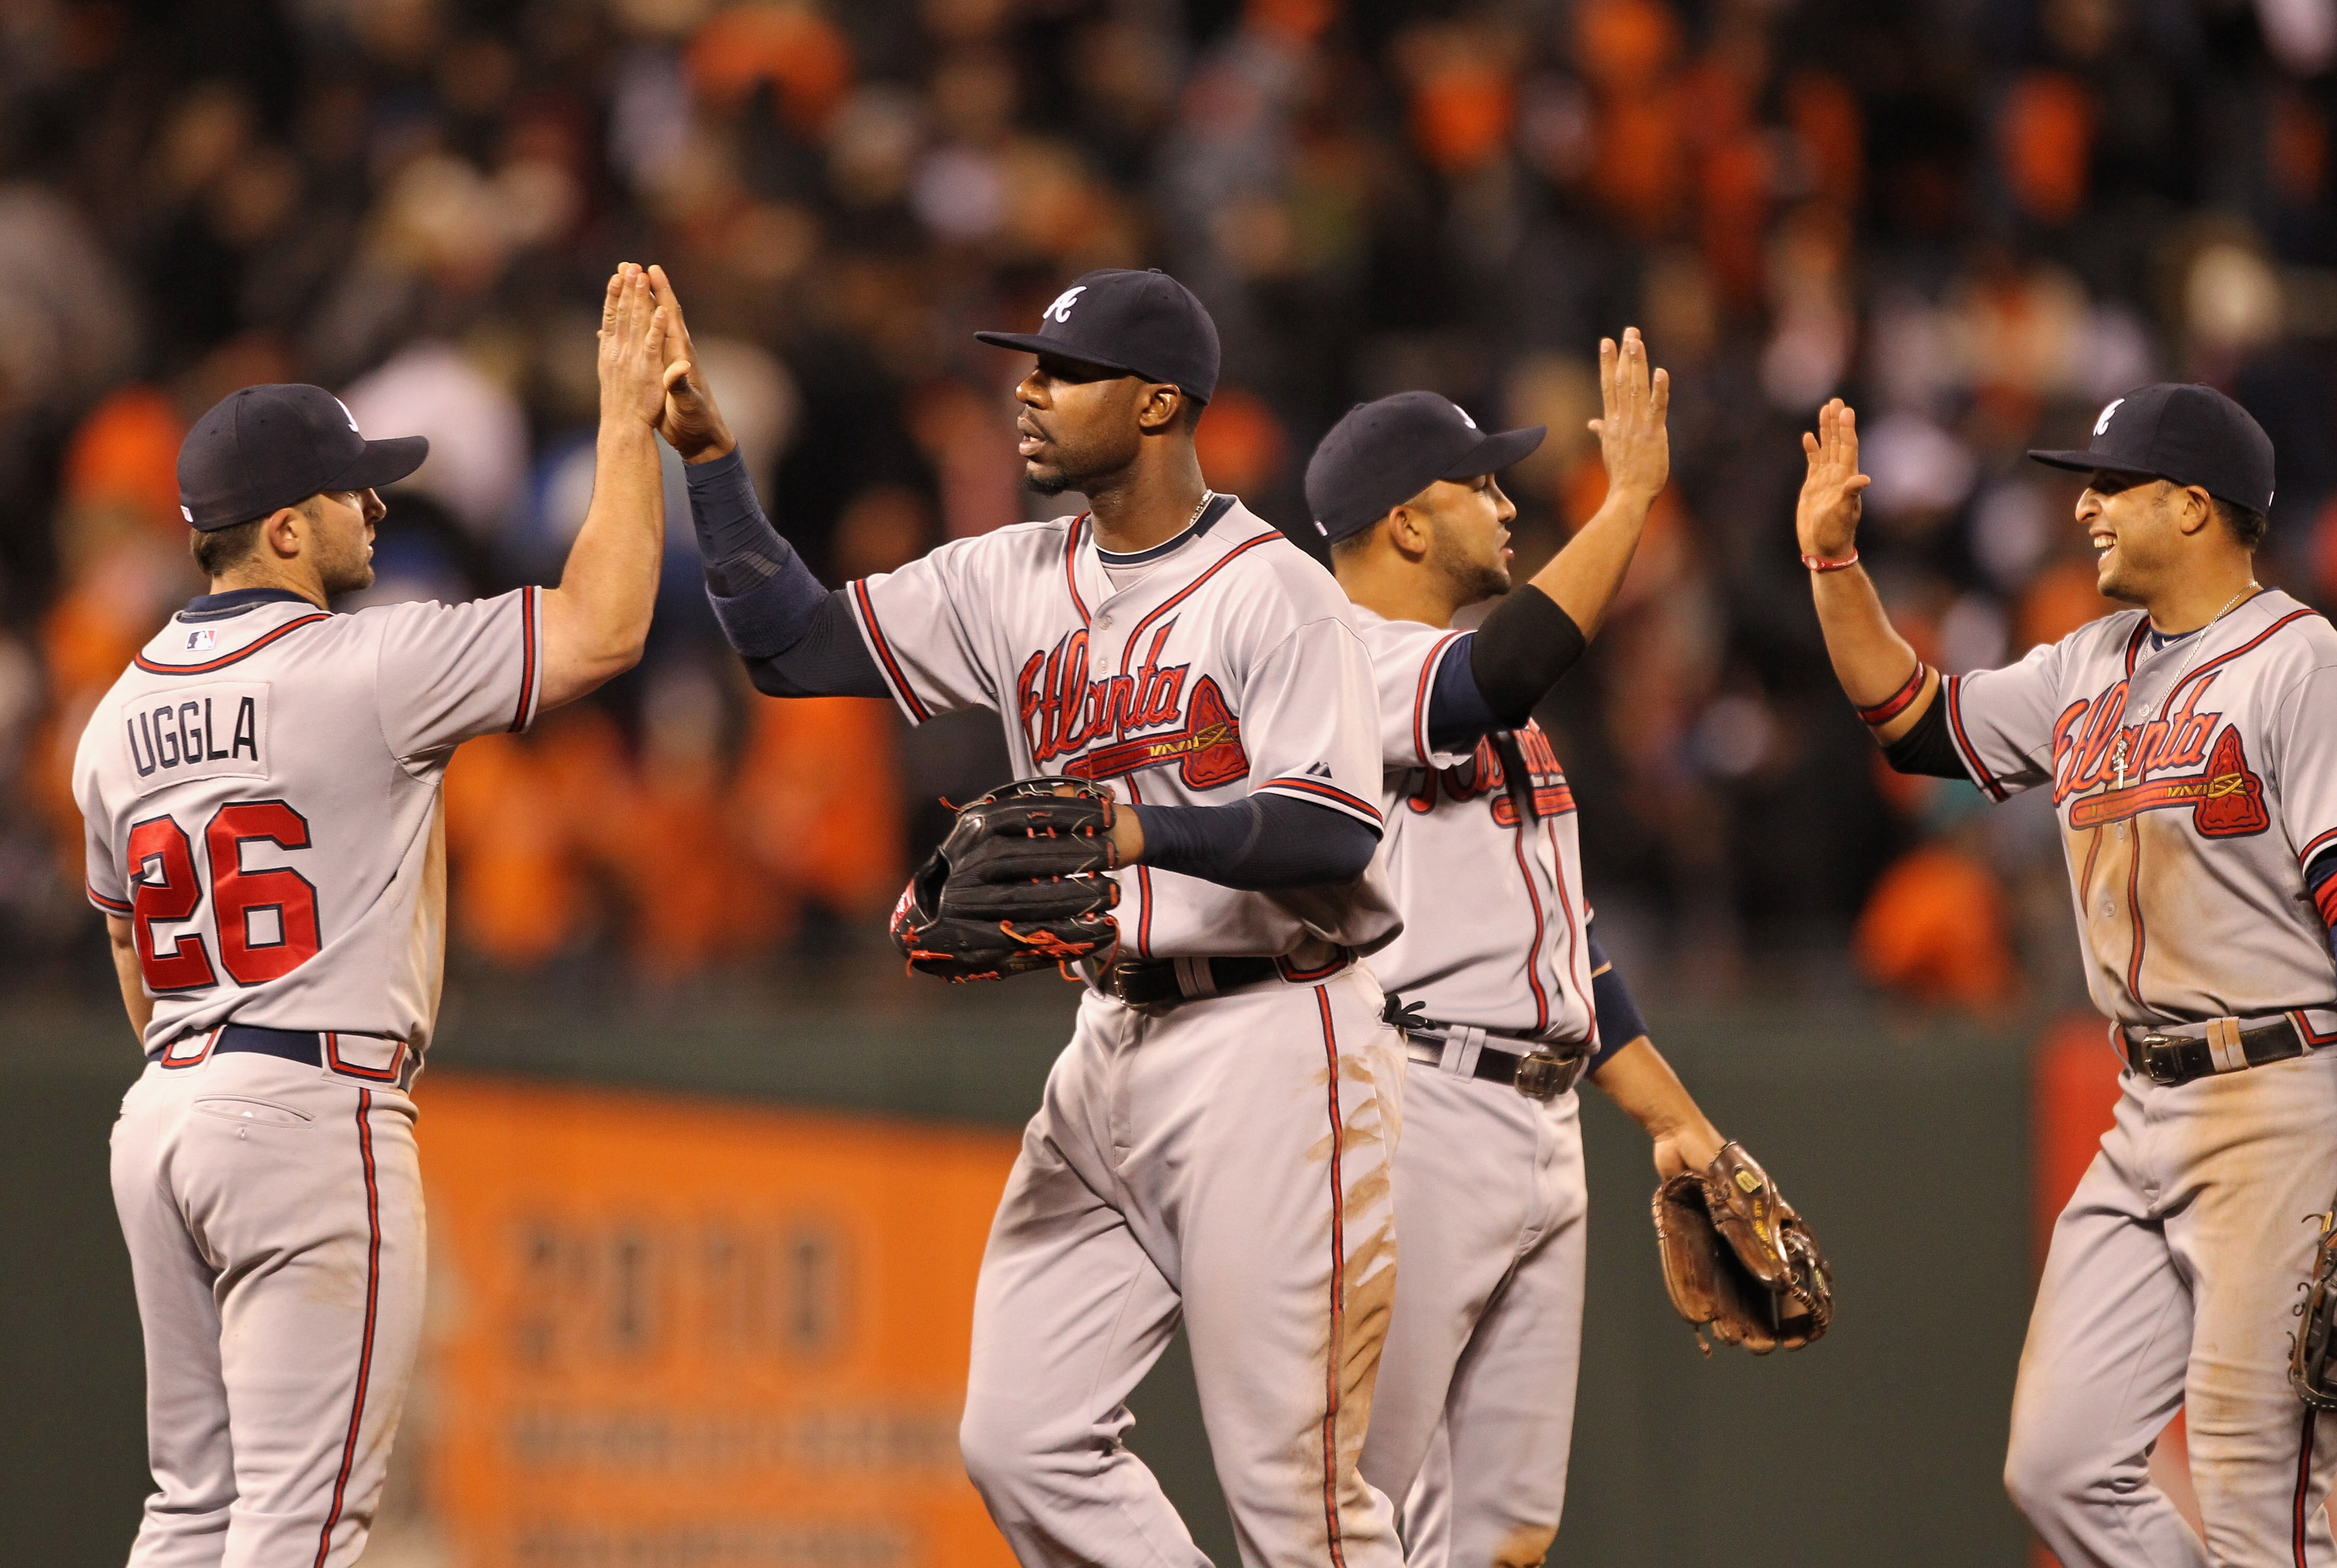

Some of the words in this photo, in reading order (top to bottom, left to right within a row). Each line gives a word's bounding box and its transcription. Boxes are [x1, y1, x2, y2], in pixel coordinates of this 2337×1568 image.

[1042, 285, 1088, 324] A
[126, 696, 259, 778] UGGLA
[1017, 612, 1191, 765] Atlanta
[2053, 669, 2223, 808] Atlanta
[127, 799, 323, 993] 26
